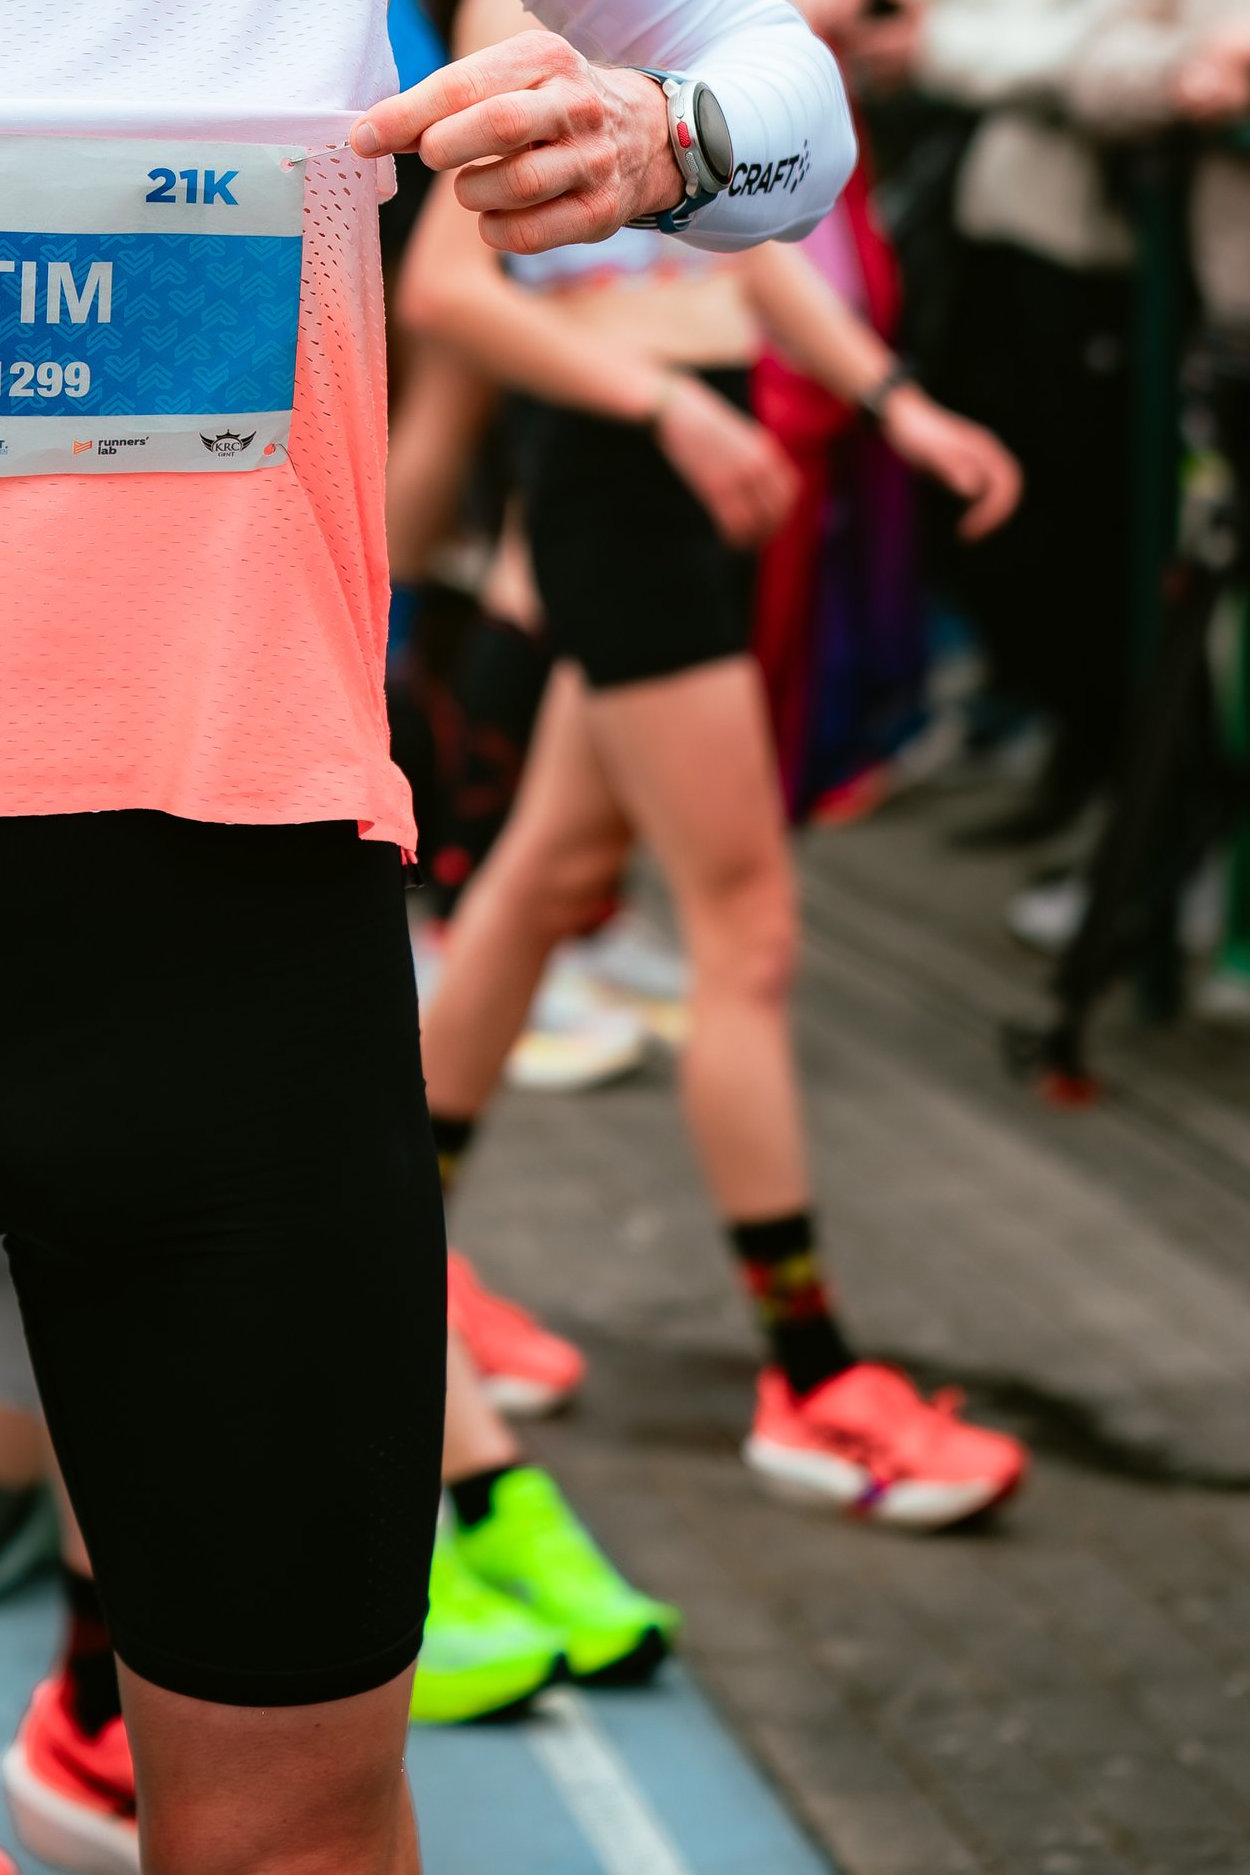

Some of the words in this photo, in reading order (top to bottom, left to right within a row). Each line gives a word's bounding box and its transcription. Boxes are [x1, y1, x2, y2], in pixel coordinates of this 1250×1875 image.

[728, 154, 800, 198] CRAFT
[145, 167, 240, 206] 21K
[98, 436, 149, 447] runners'
[215, 442, 240, 452] KRC
[97, 446, 117, 455] lab
